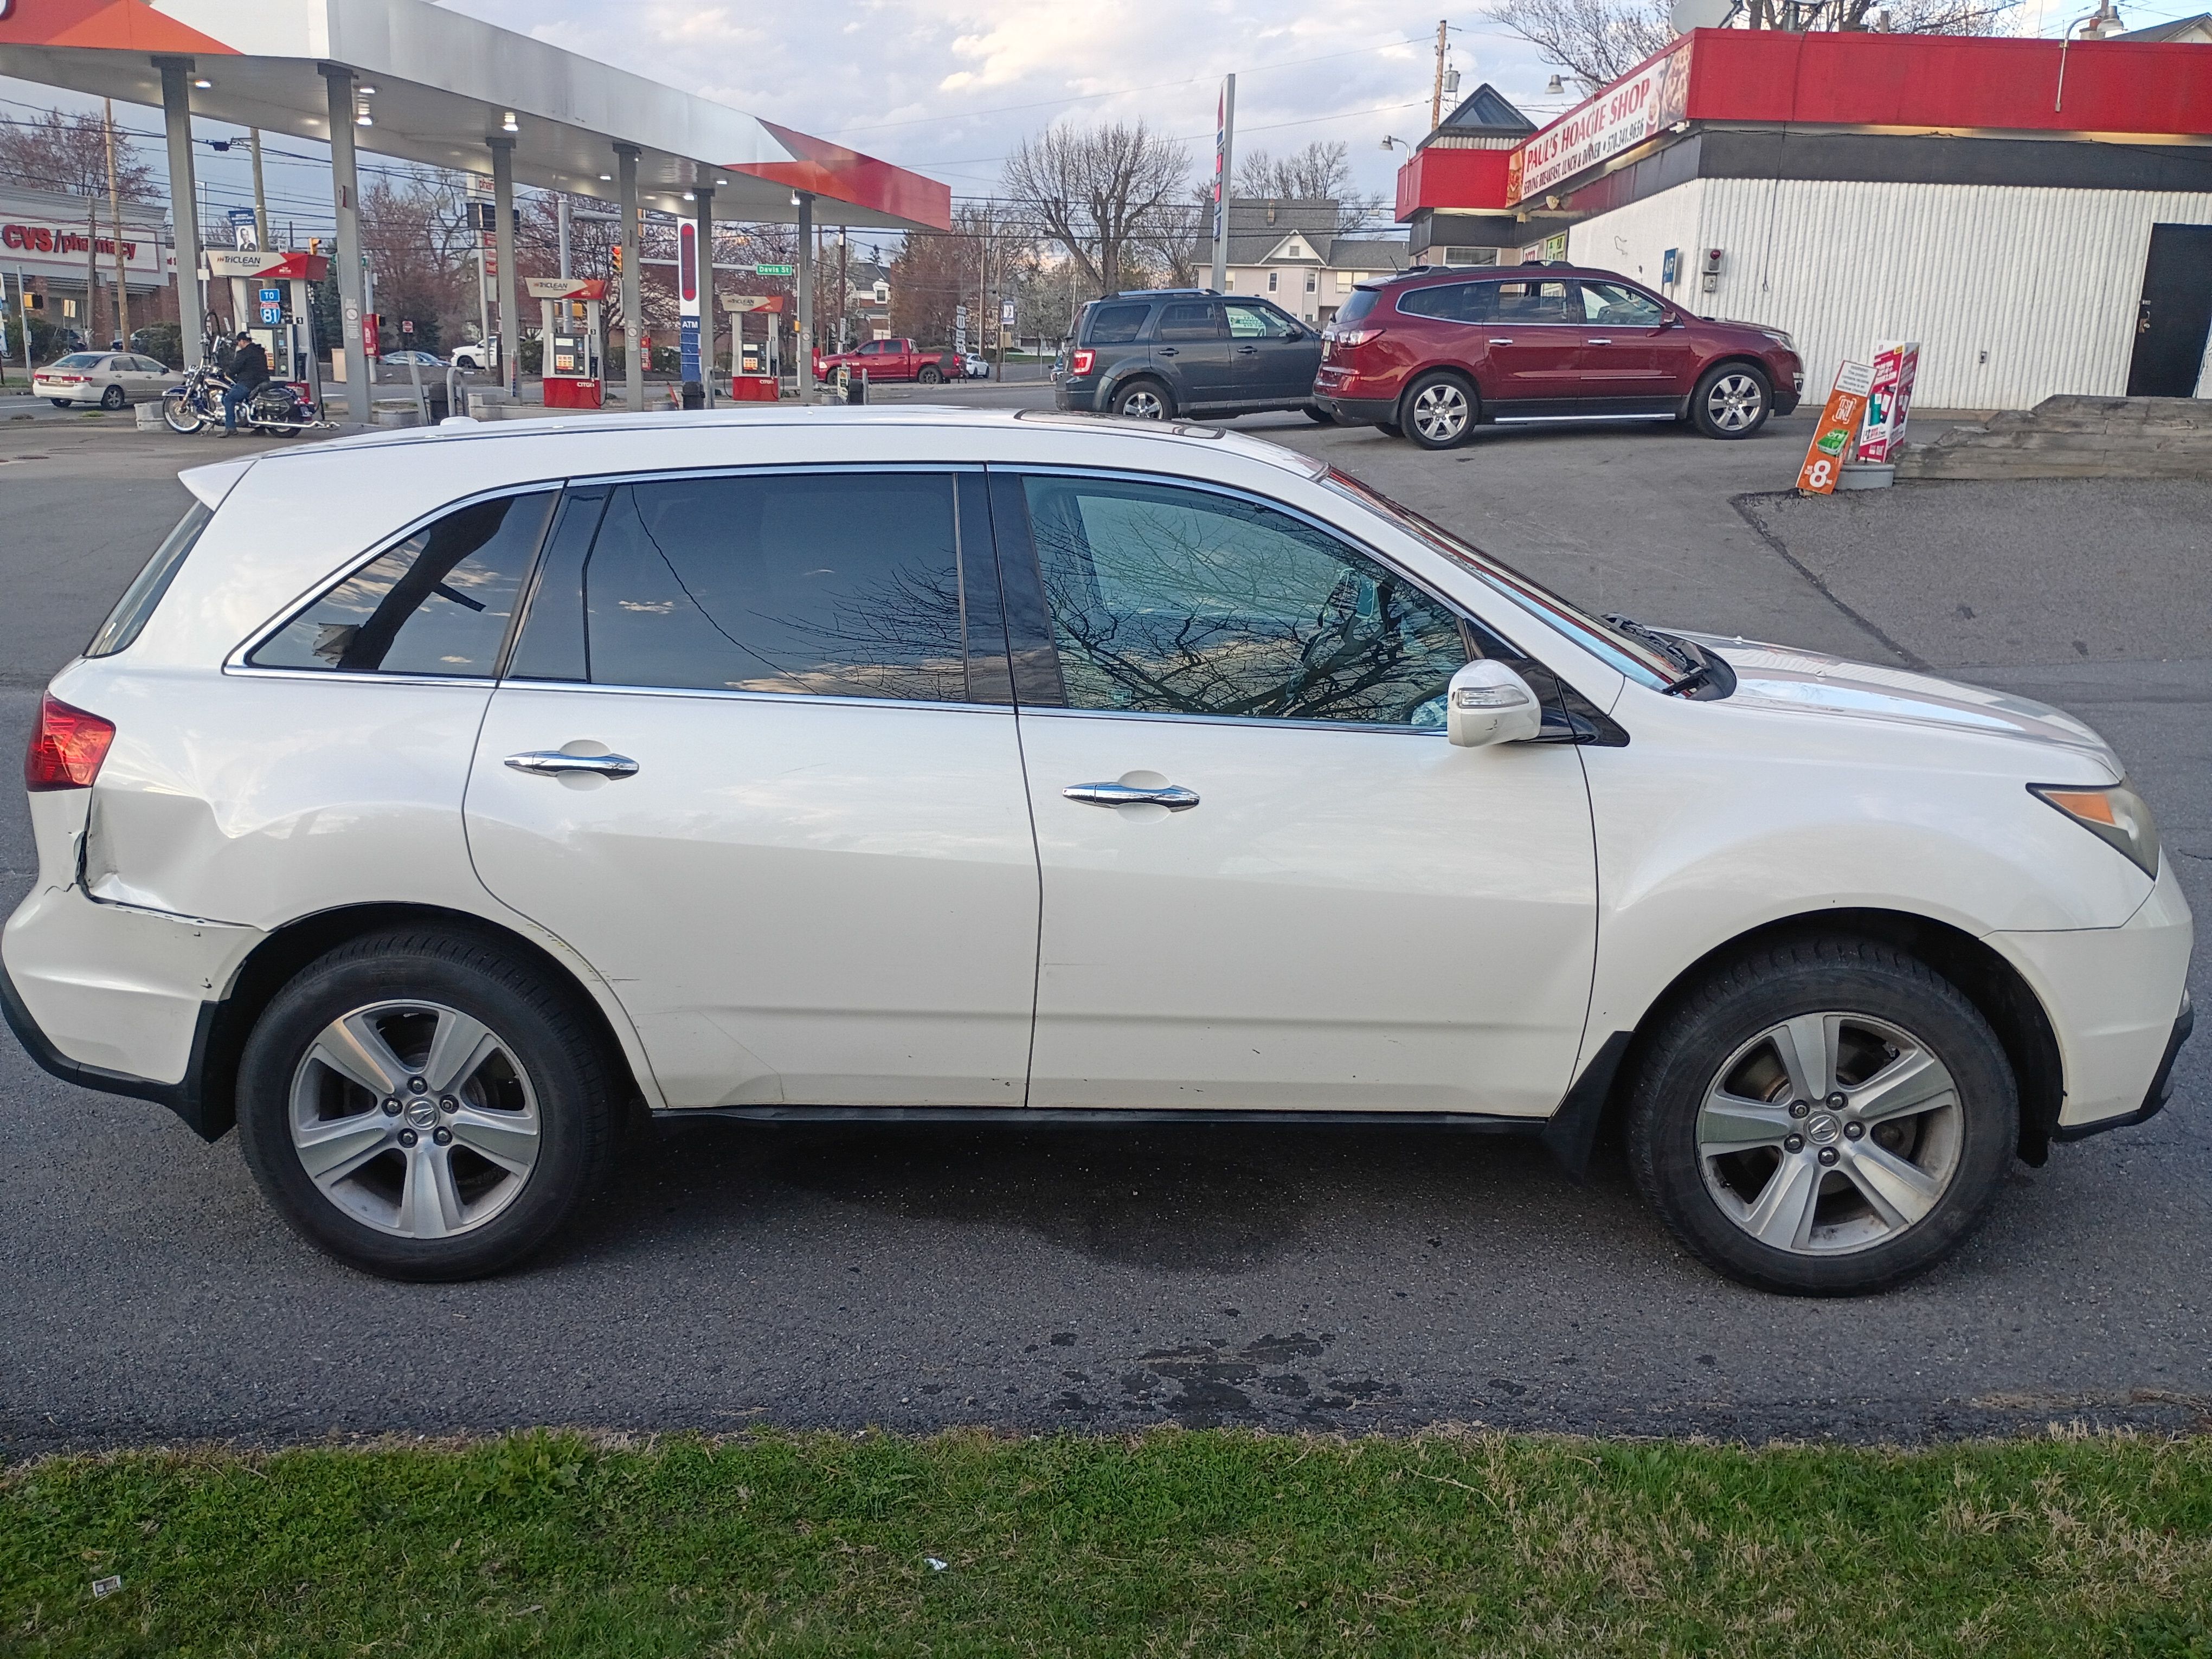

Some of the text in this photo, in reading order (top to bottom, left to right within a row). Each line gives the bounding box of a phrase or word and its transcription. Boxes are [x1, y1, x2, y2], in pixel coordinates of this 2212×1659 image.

[1526, 133, 1558, 173] PAUL'S
[1609, 78, 1650, 125] SHOP
[1523, 175, 1539, 196] SERVING
[1562, 154, 1577, 176] LUNCH
[1664, 257, 1674, 275] AIR
[263, 309, 277, 323] 81
[1810, 460, 1831, 487] 8
